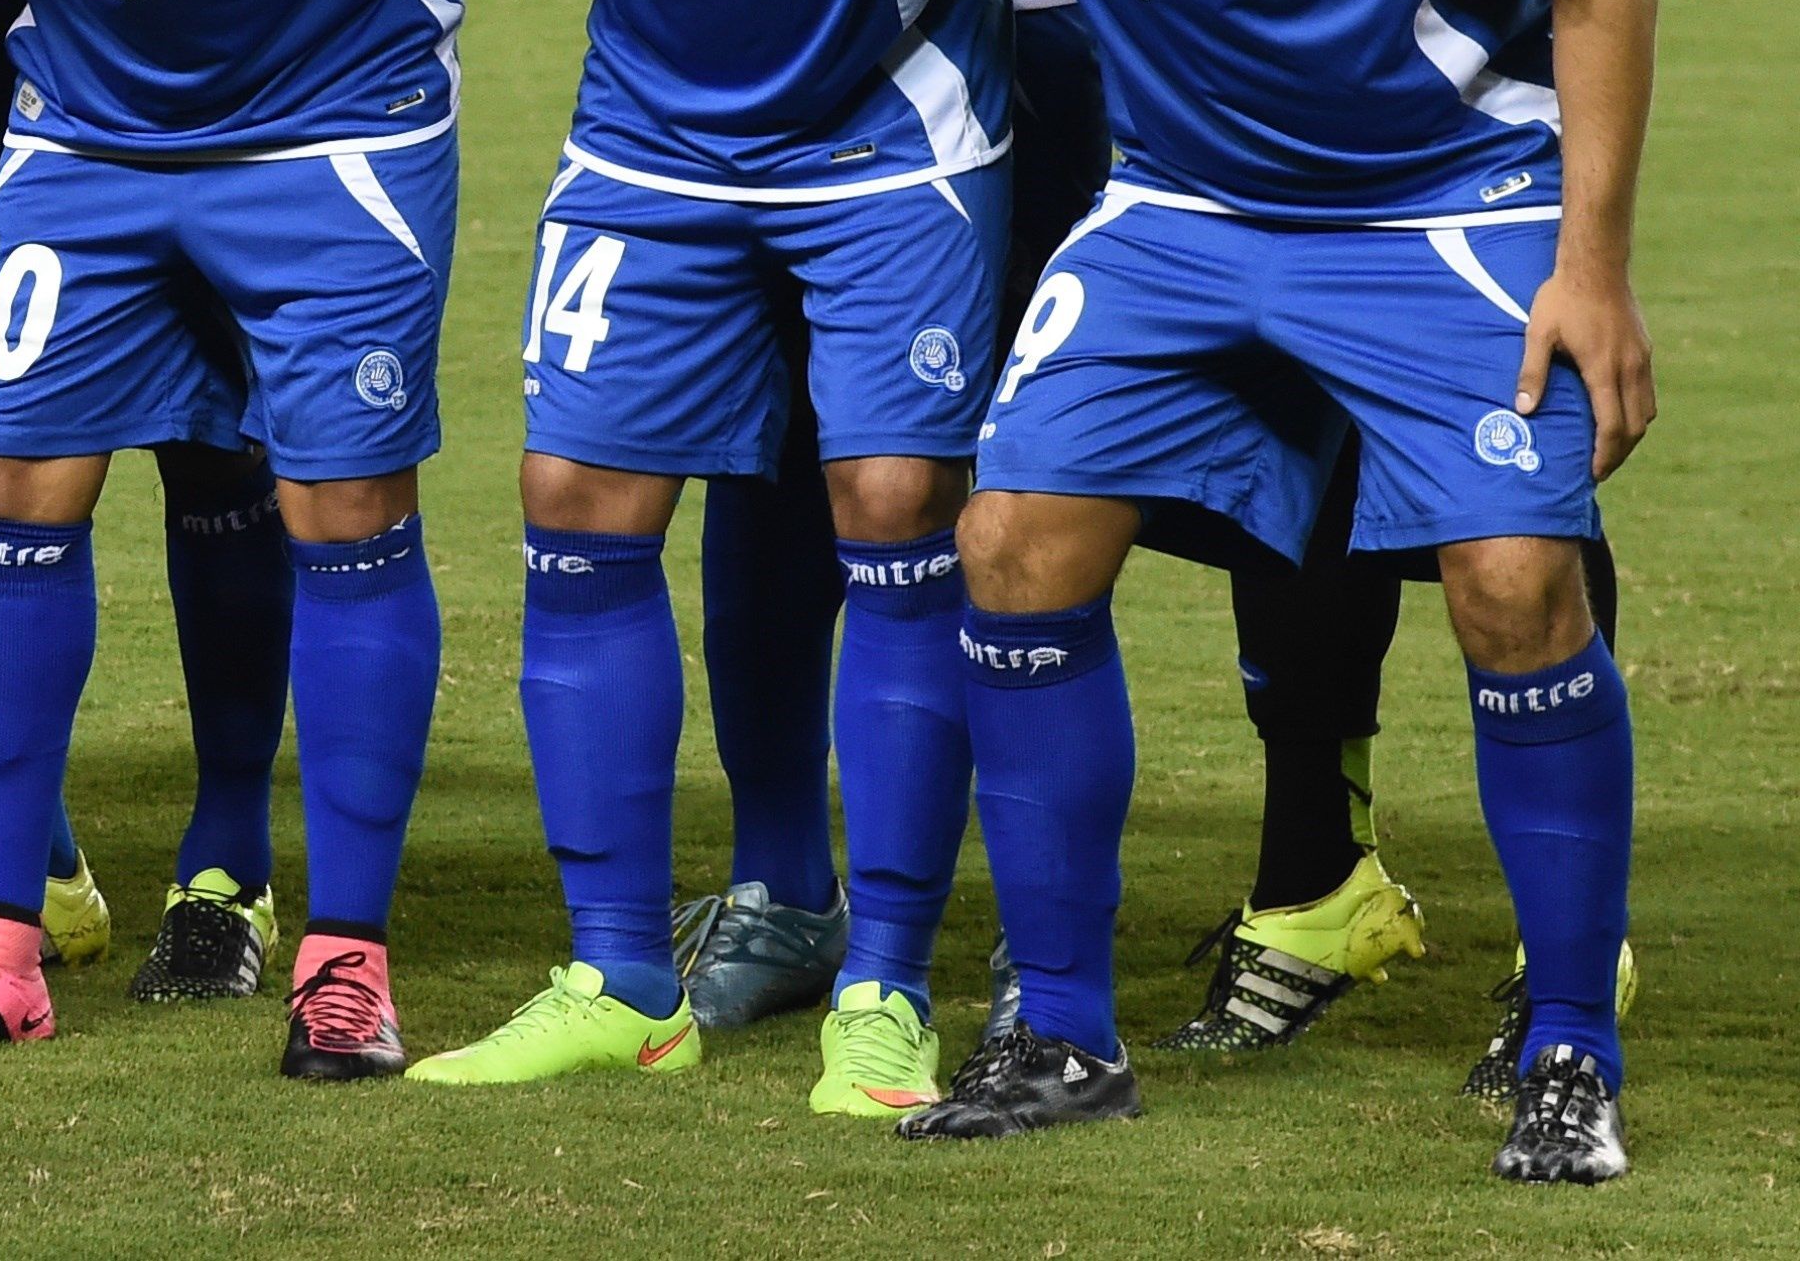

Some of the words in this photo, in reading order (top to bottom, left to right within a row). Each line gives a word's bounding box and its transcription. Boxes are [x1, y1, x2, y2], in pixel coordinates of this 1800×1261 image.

[521, 221, 627, 373] 14
[996, 271, 1085, 403] 9
[843, 554, 958, 586] mitre
[1478, 672, 1595, 714] mitre
